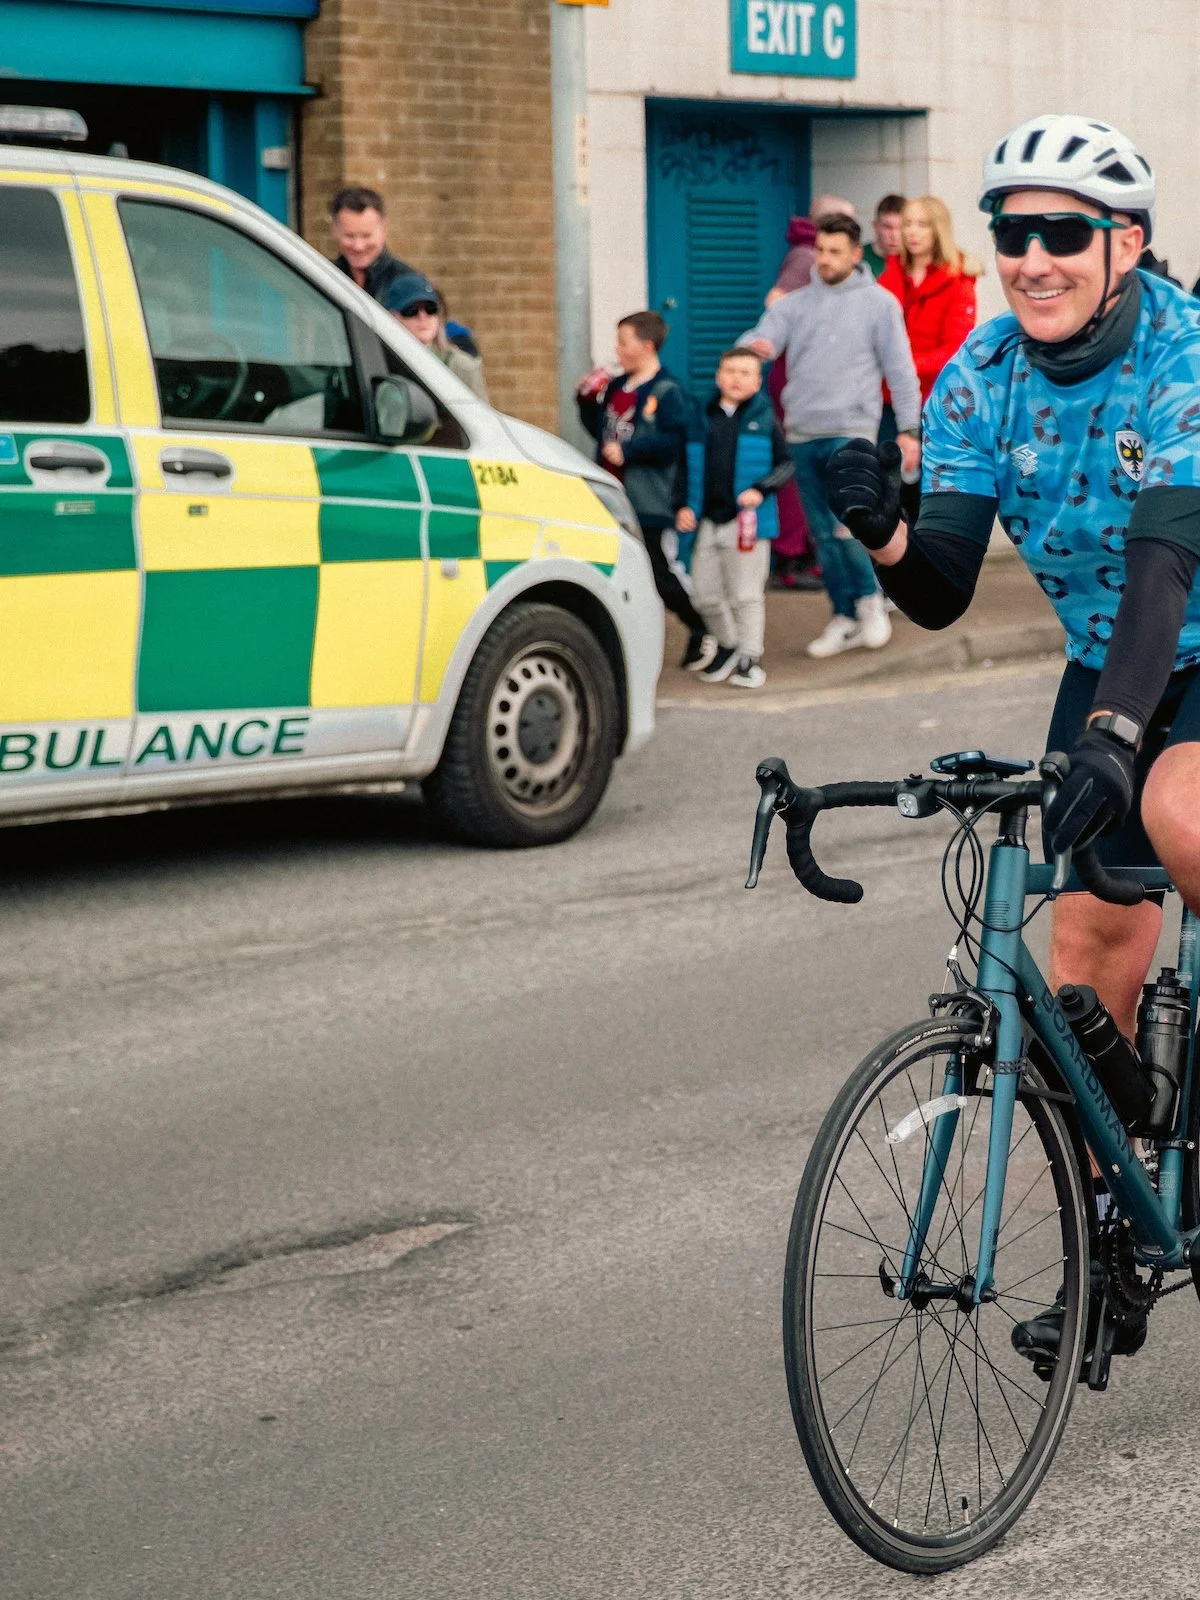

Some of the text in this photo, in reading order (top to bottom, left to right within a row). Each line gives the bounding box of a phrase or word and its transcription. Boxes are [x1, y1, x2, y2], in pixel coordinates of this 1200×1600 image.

[747, 1, 846, 60] EXIT C
[0, 716, 310, 773] BULANCE
[1041, 984, 1138, 1165] BOARDMAN
